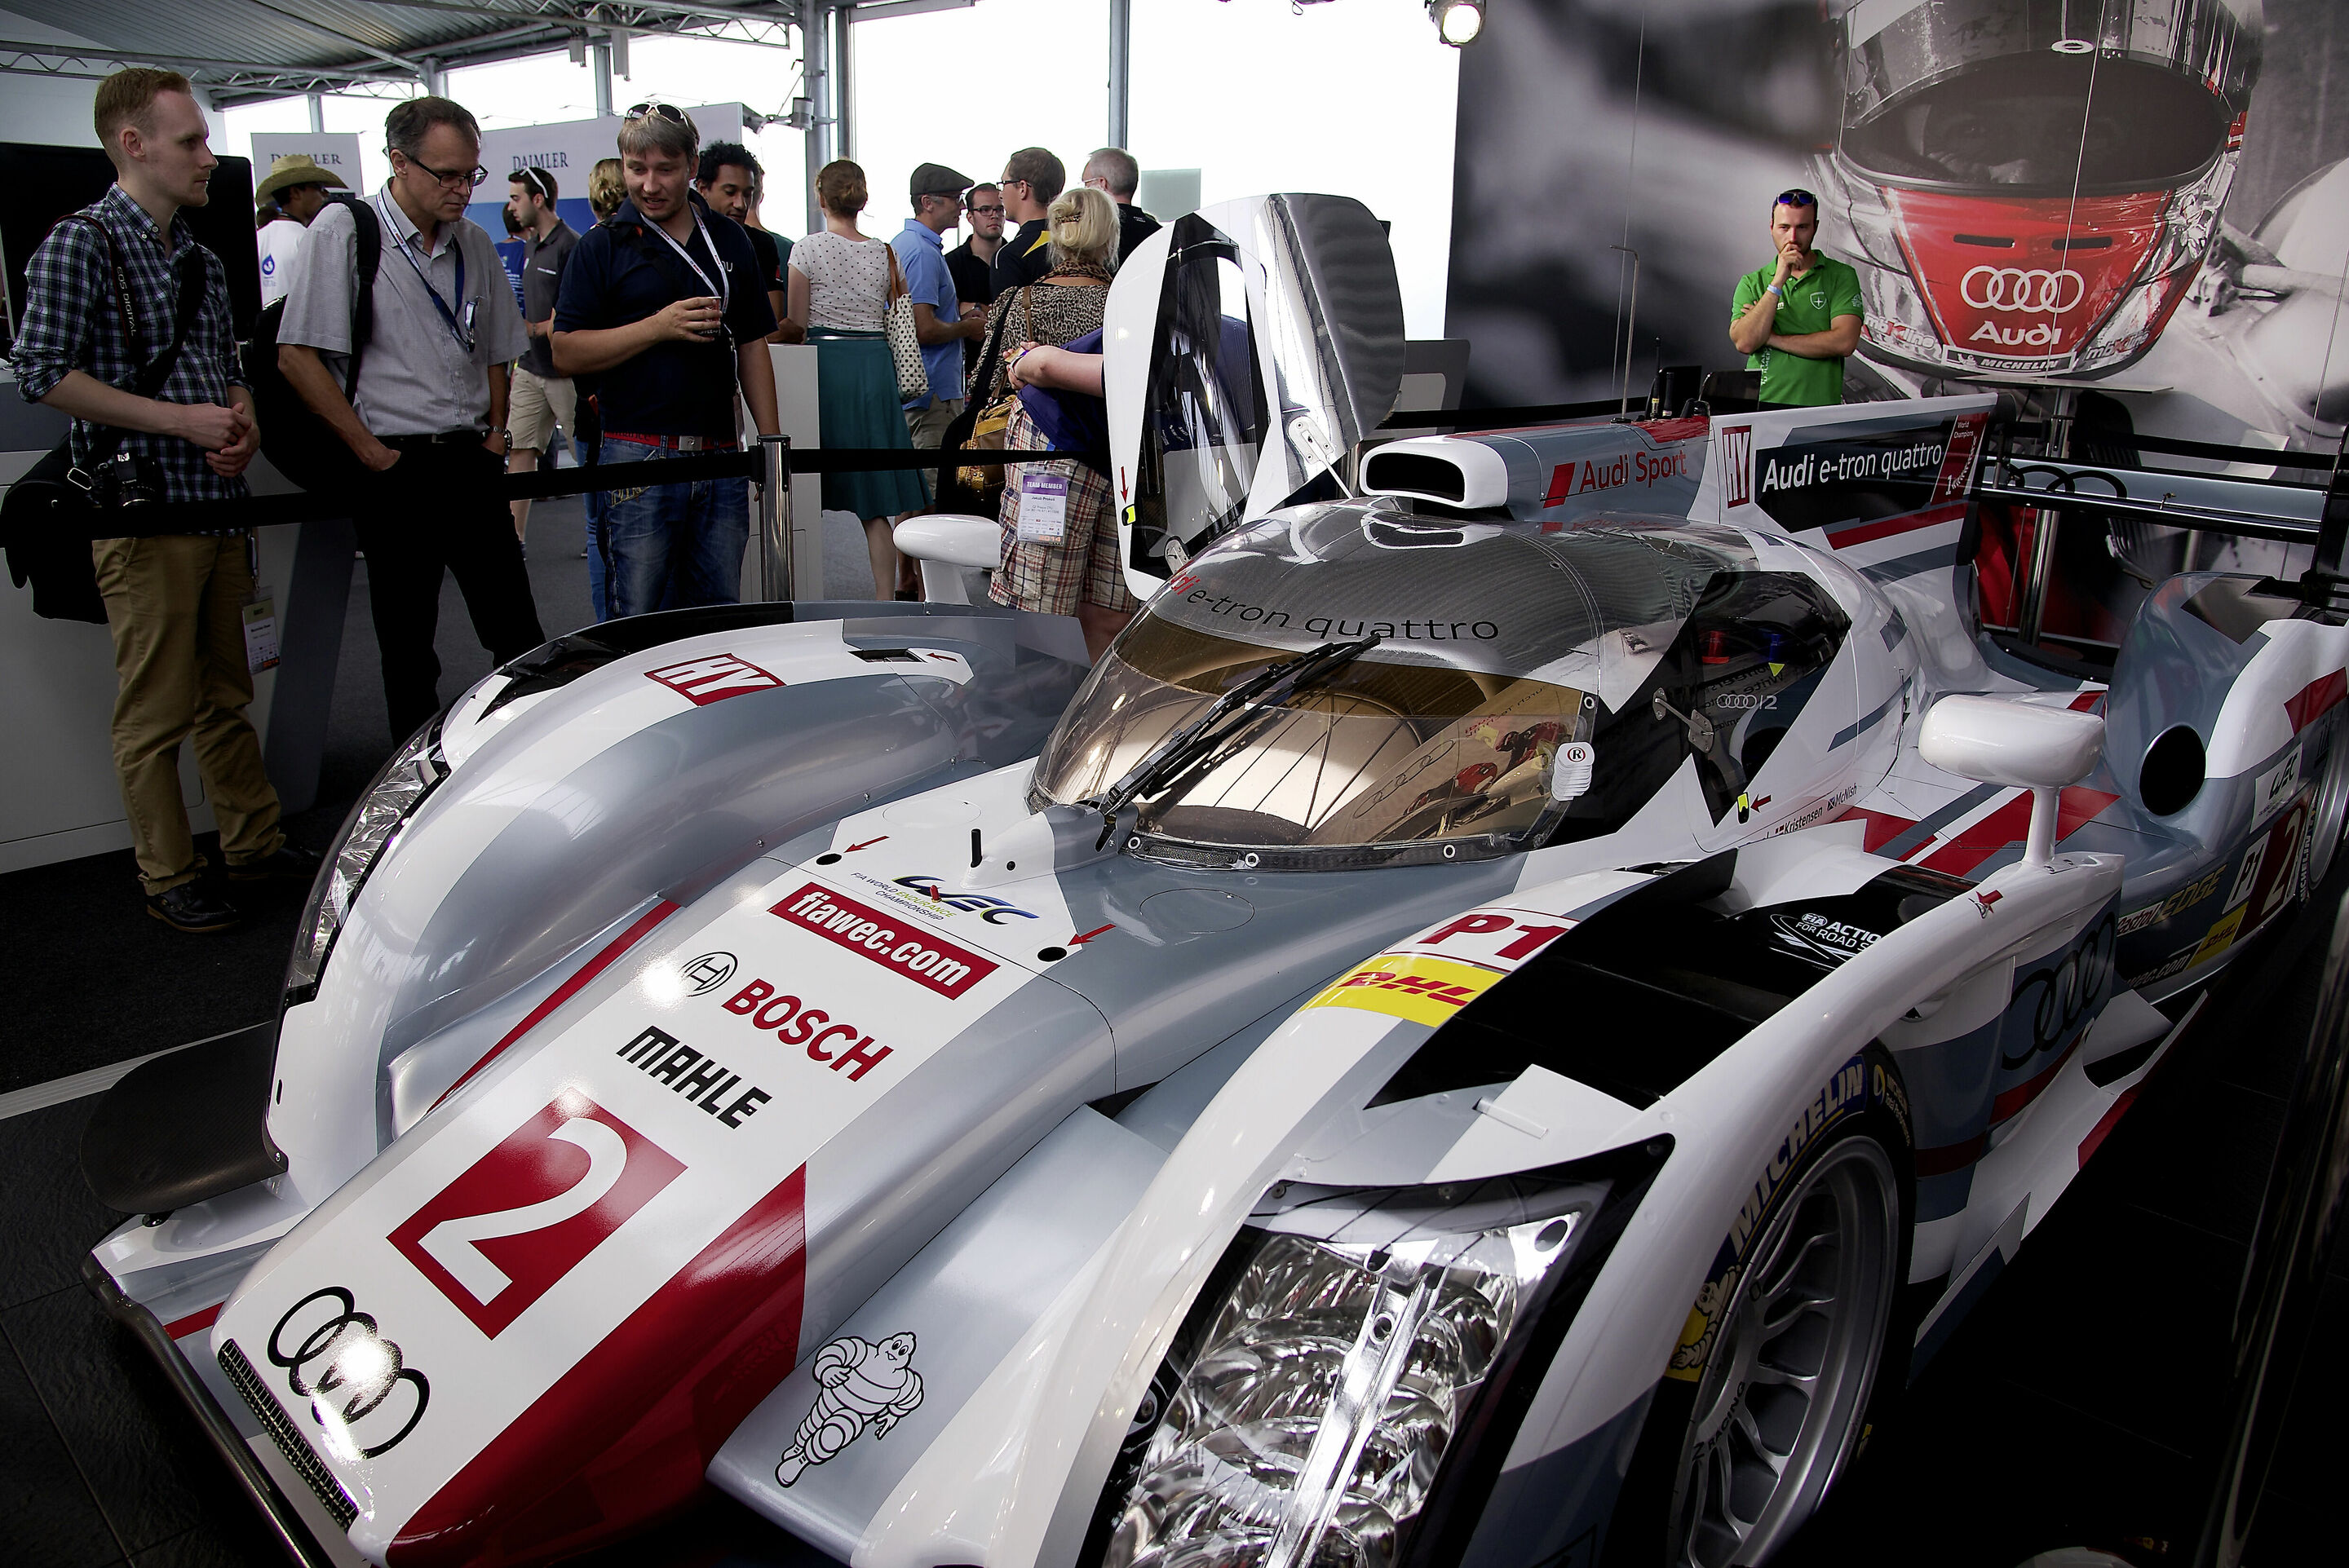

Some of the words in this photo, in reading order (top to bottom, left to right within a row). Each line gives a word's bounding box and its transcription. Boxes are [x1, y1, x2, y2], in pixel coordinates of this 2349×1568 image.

[512, 152, 568, 171] DAIMLER
[117, 266, 128, 290] EOS
[123, 294, 137, 337] DIGITAL
[1970, 321, 2063, 346] Audi
[1980, 357, 2059, 370] MICHELIN
[1954, 431, 1974, 439] Champions
[1579, 454, 1630, 493] Audi
[1635, 449, 1687, 488] Sport
[1723, 432, 1750, 501] HY
[1763, 453, 1815, 492] Audi
[1820, 453, 1876, 483] e-tron
[1881, 443, 1942, 479] quattro
[1187, 588, 1290, 629] e-tron
[1304, 616, 1500, 641] quattro
[652, 656, 777, 696] HY
[1784, 806, 1823, 834] Kristensen
[1834, 783, 1858, 807] McNish
[2231, 843, 2265, 903] P1
[2260, 807, 2303, 916] 2
[851, 872, 868, 881] FIA
[866, 878, 899, 894] WORLD
[896, 890, 958, 918] ENDURANCE
[875, 890, 945, 921] CHAMPIONSHIP
[2162, 864, 2228, 917] EDGE
[787, 890, 972, 987] fiawec.com
[1416, 914, 1570, 961] P1
[1796, 922, 1817, 934] FOR
[1816, 930, 1858, 947] ROAD
[1803, 914, 1825, 925] FIA
[1825, 921, 1882, 944] ACTIO
[1338, 971, 1477, 1007] DHL
[721, 978, 895, 1083] BOSCH
[615, 1025, 773, 1130] MAHLE
[1728, 1063, 1864, 1257] MICHELIN
[417, 1116, 628, 1308] 2
[1708, 1381, 1745, 1450] RACING
